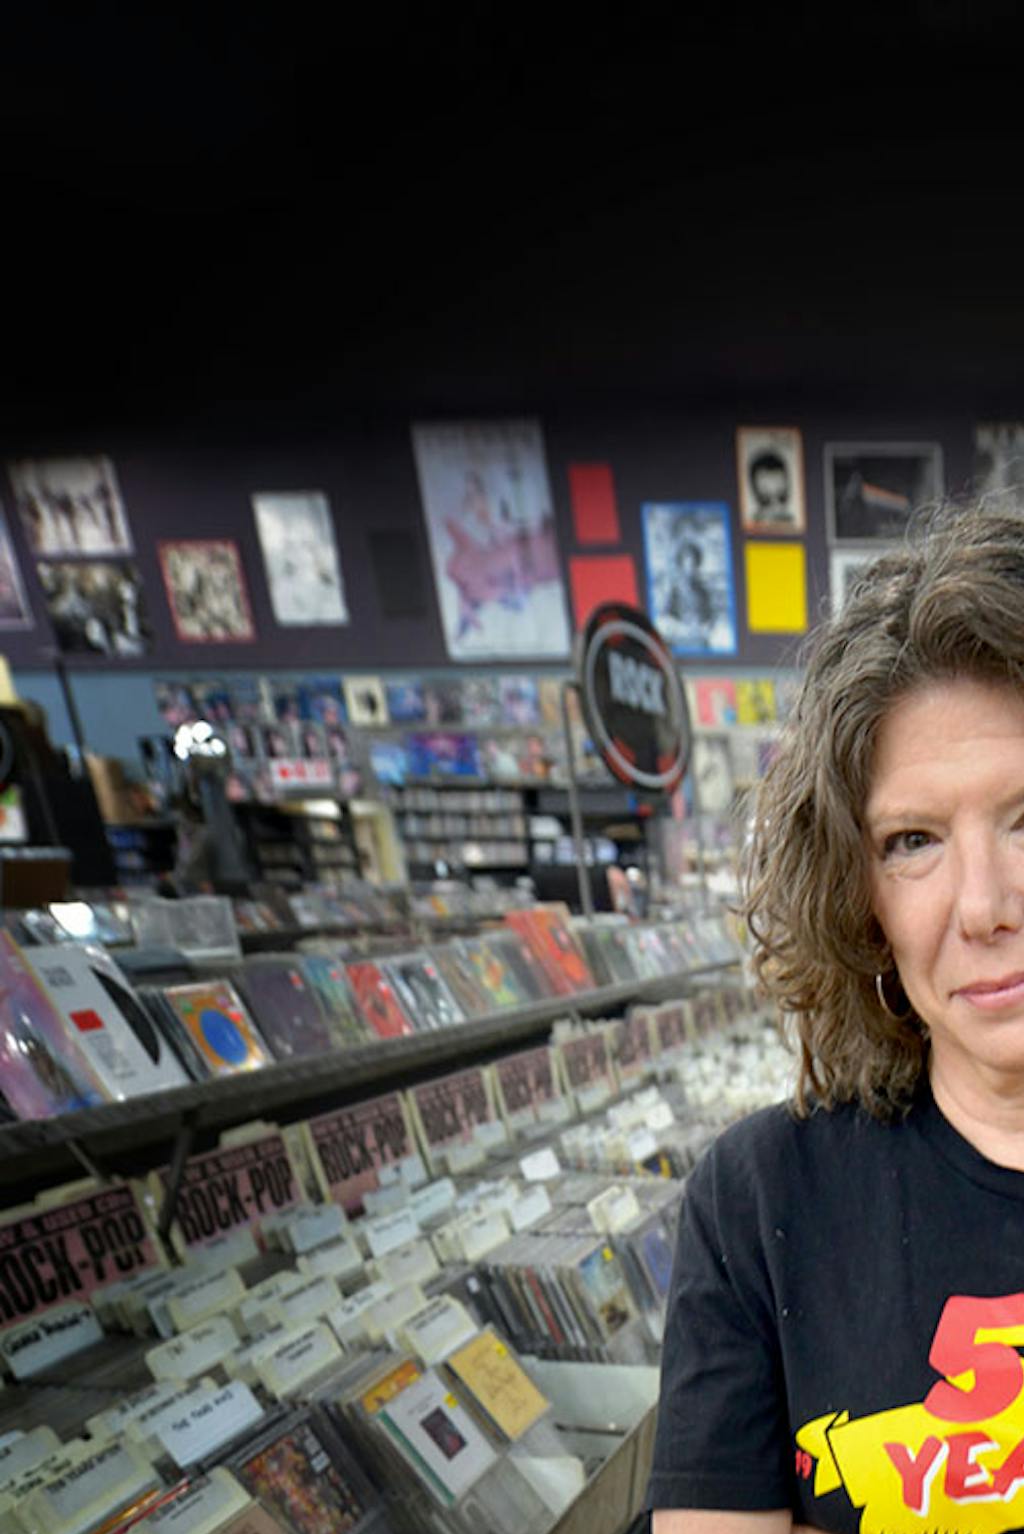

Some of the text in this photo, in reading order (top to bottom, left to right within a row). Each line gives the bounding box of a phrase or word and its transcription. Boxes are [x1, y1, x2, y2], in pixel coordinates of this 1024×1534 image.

[606, 648, 667, 716] ROCK
[176, 1153, 295, 1244] ROCK-POP
[0, 1207, 147, 1326] OCK-POP
